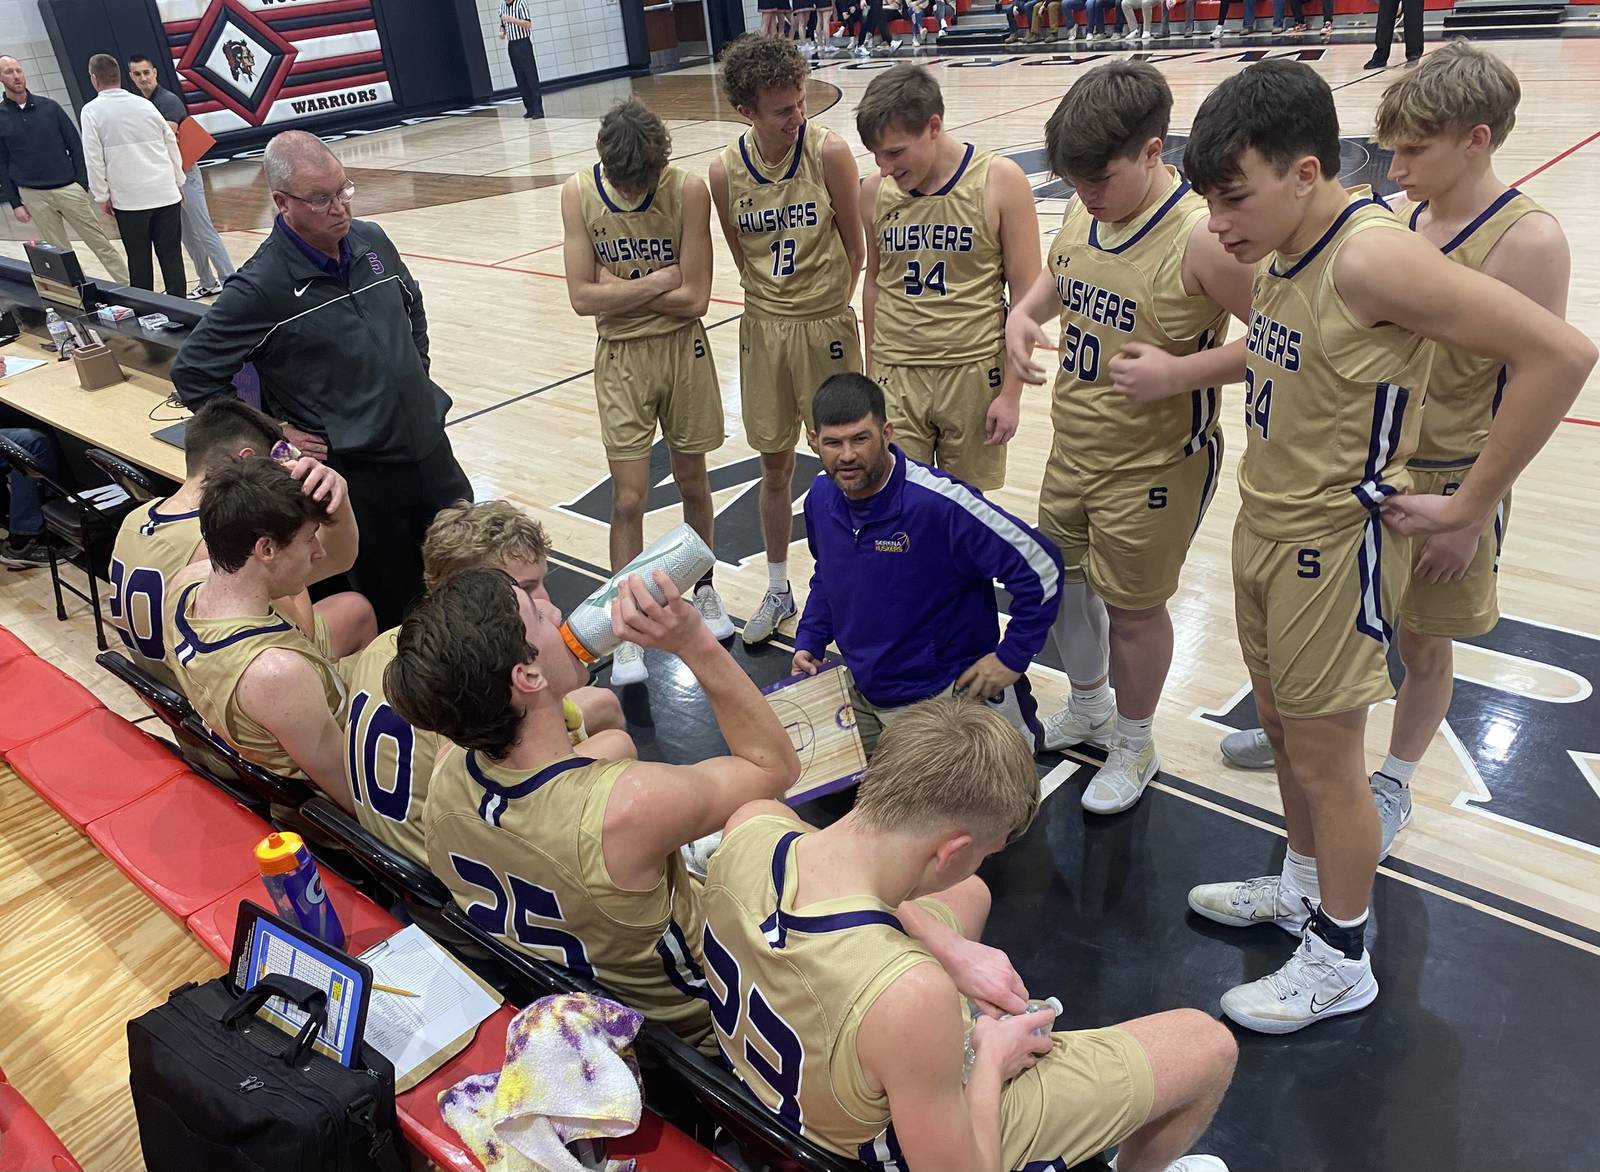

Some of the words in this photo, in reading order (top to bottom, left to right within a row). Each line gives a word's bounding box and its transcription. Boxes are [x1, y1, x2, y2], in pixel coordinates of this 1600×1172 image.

[291, 88, 378, 115] WARRIORS
[738, 201, 818, 235] HUSKERS
[594, 237, 675, 264] HUSKERS
[883, 224, 973, 253] HUSKERS
[769, 238, 798, 277] 13
[903, 260, 947, 297] 34
[1056, 273, 1137, 333] USKERS
[829, 340, 844, 360] S
[1062, 321, 1101, 383] 30
[988, 366, 1002, 388] S
[1147, 486, 1168, 510] S
[1296, 548, 1321, 579] S
[346, 688, 416, 824] 10
